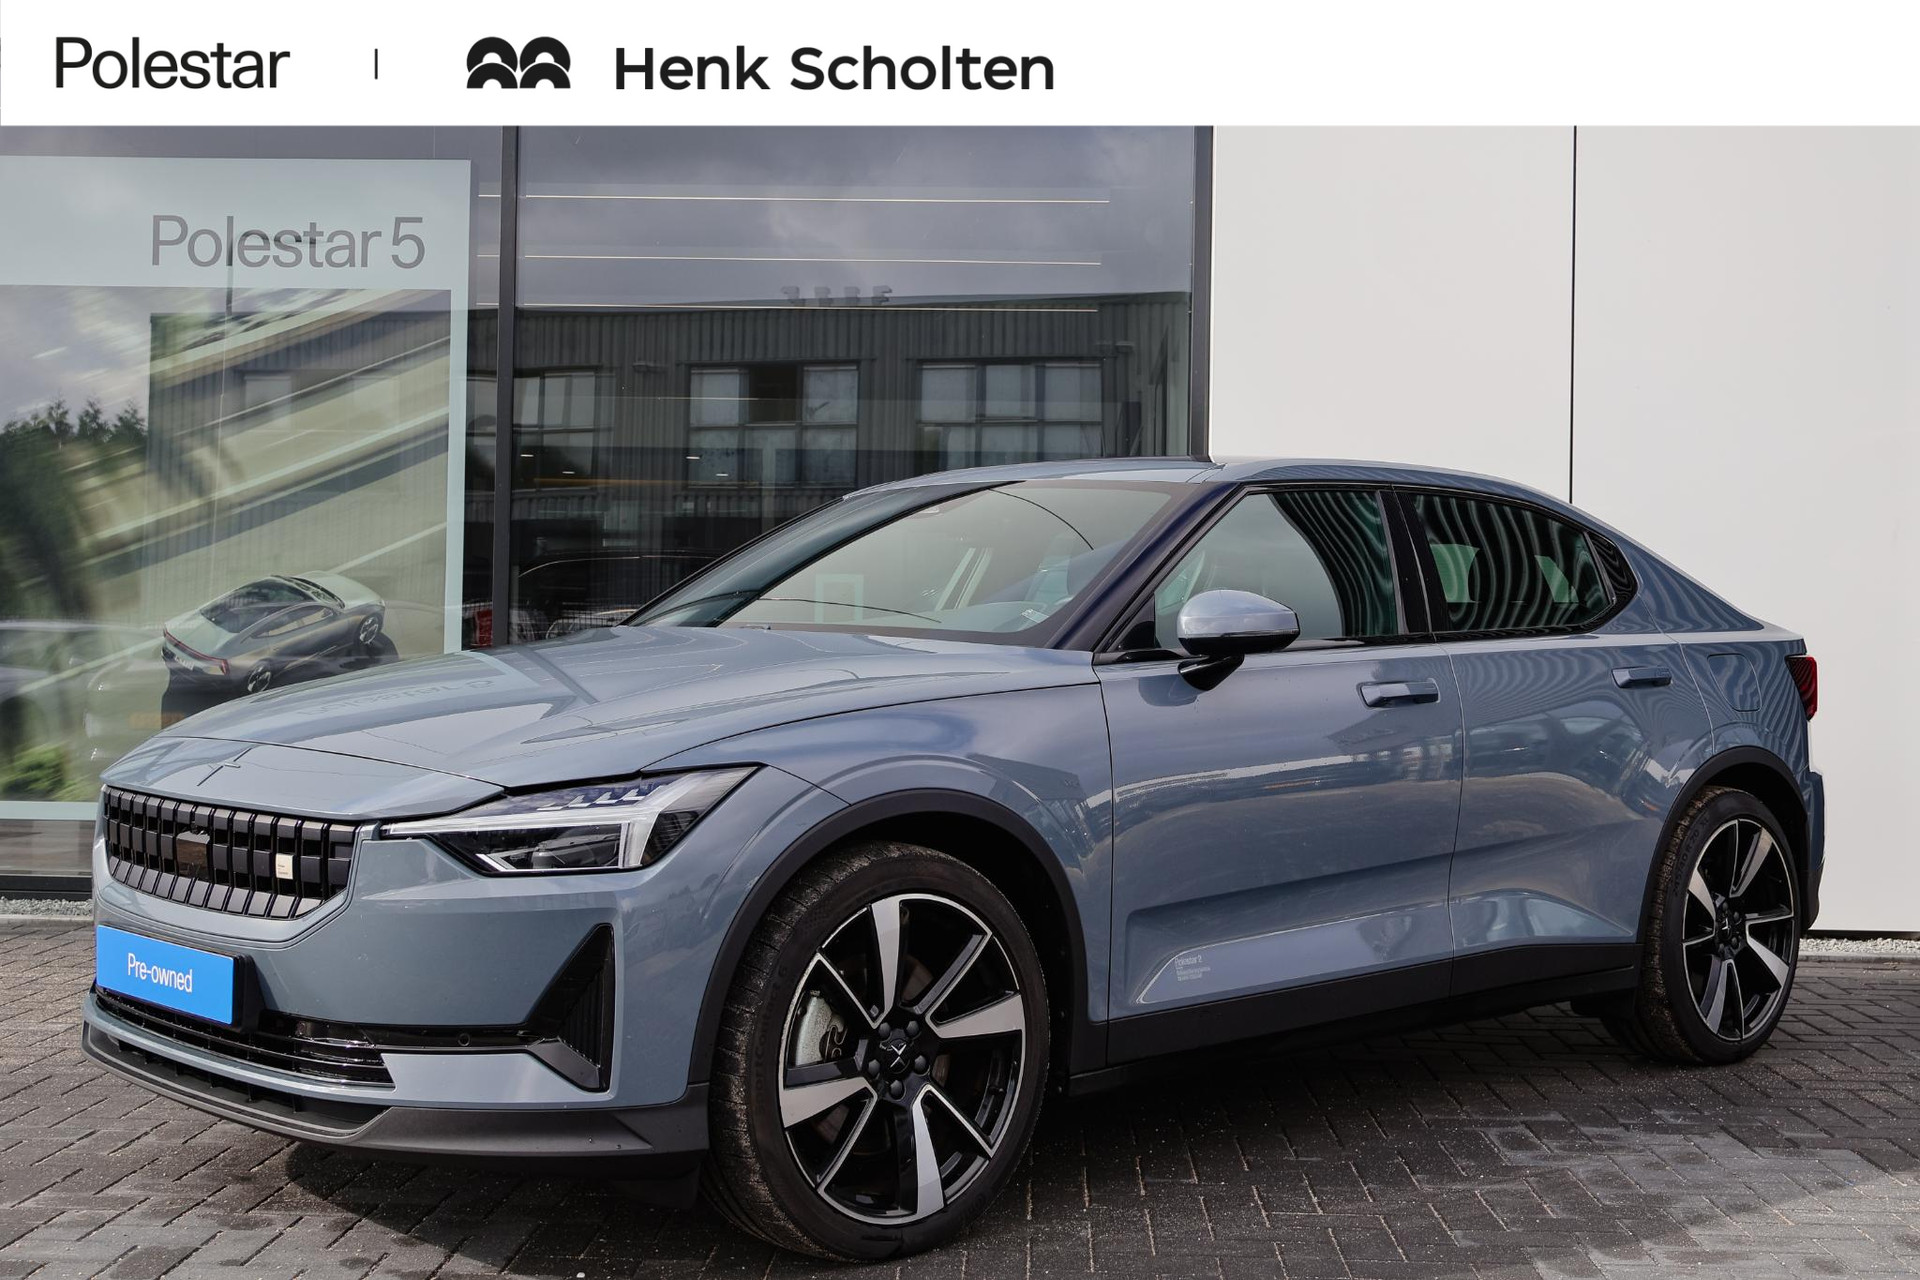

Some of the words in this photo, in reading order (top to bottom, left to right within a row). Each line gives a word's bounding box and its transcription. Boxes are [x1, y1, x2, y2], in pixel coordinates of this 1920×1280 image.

[152, 215, 382, 268] Polestar
[391, 216, 425, 269] 5
[127, 952, 193, 994] Pre-owned
